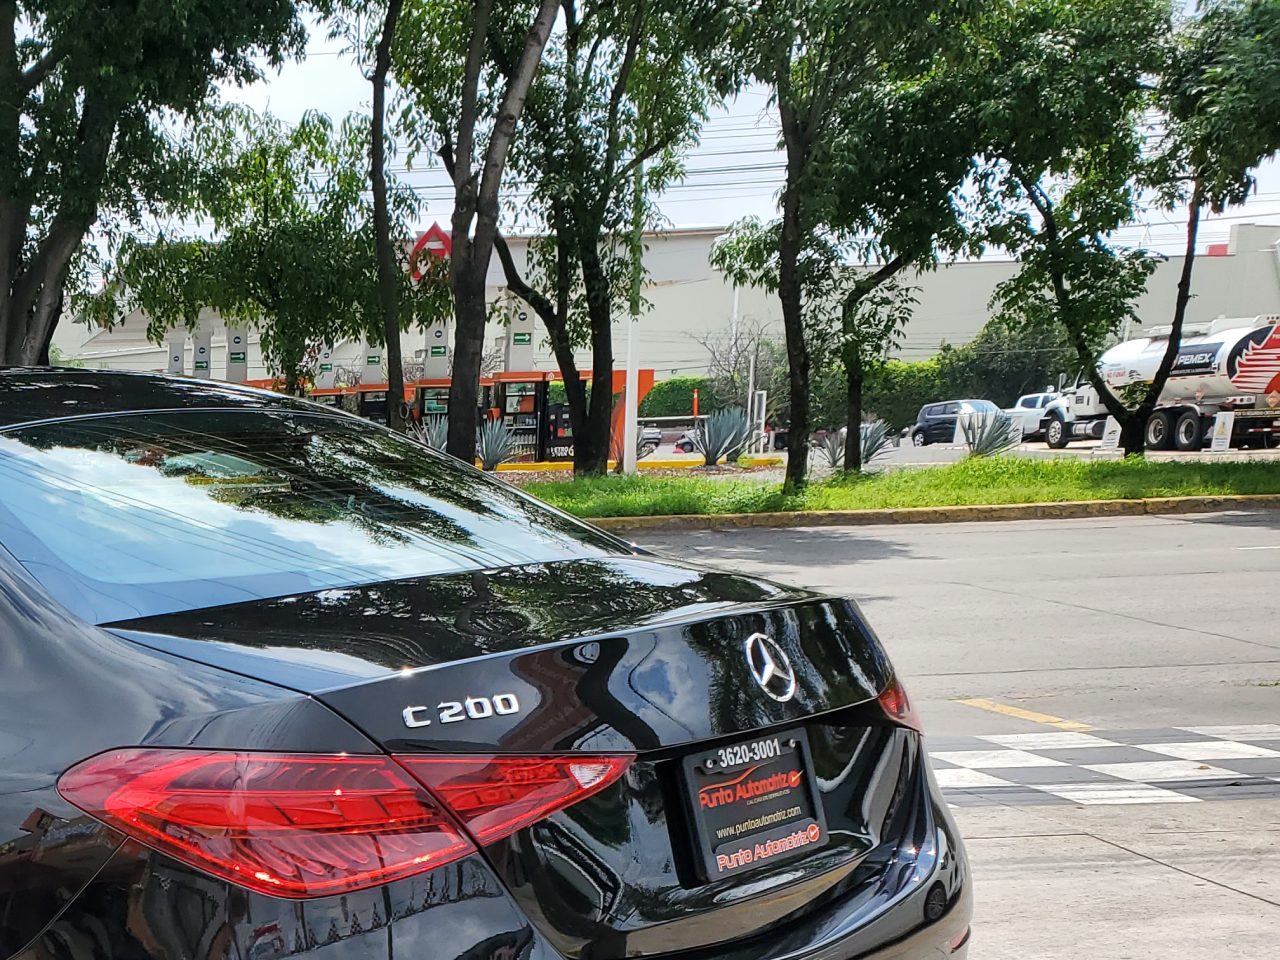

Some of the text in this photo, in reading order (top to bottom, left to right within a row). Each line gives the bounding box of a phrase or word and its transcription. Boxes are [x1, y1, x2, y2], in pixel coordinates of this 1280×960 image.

[1177, 352, 1213, 366] PEMEX
[402, 693, 520, 728] C 200
[718, 738, 781, 768] 3620-3001
[699, 770, 790, 810] Punto Automotriz
[716, 806, 802, 839] www.puntoautomotriz.com
[716, 829, 810, 873] Punto Automotriz
